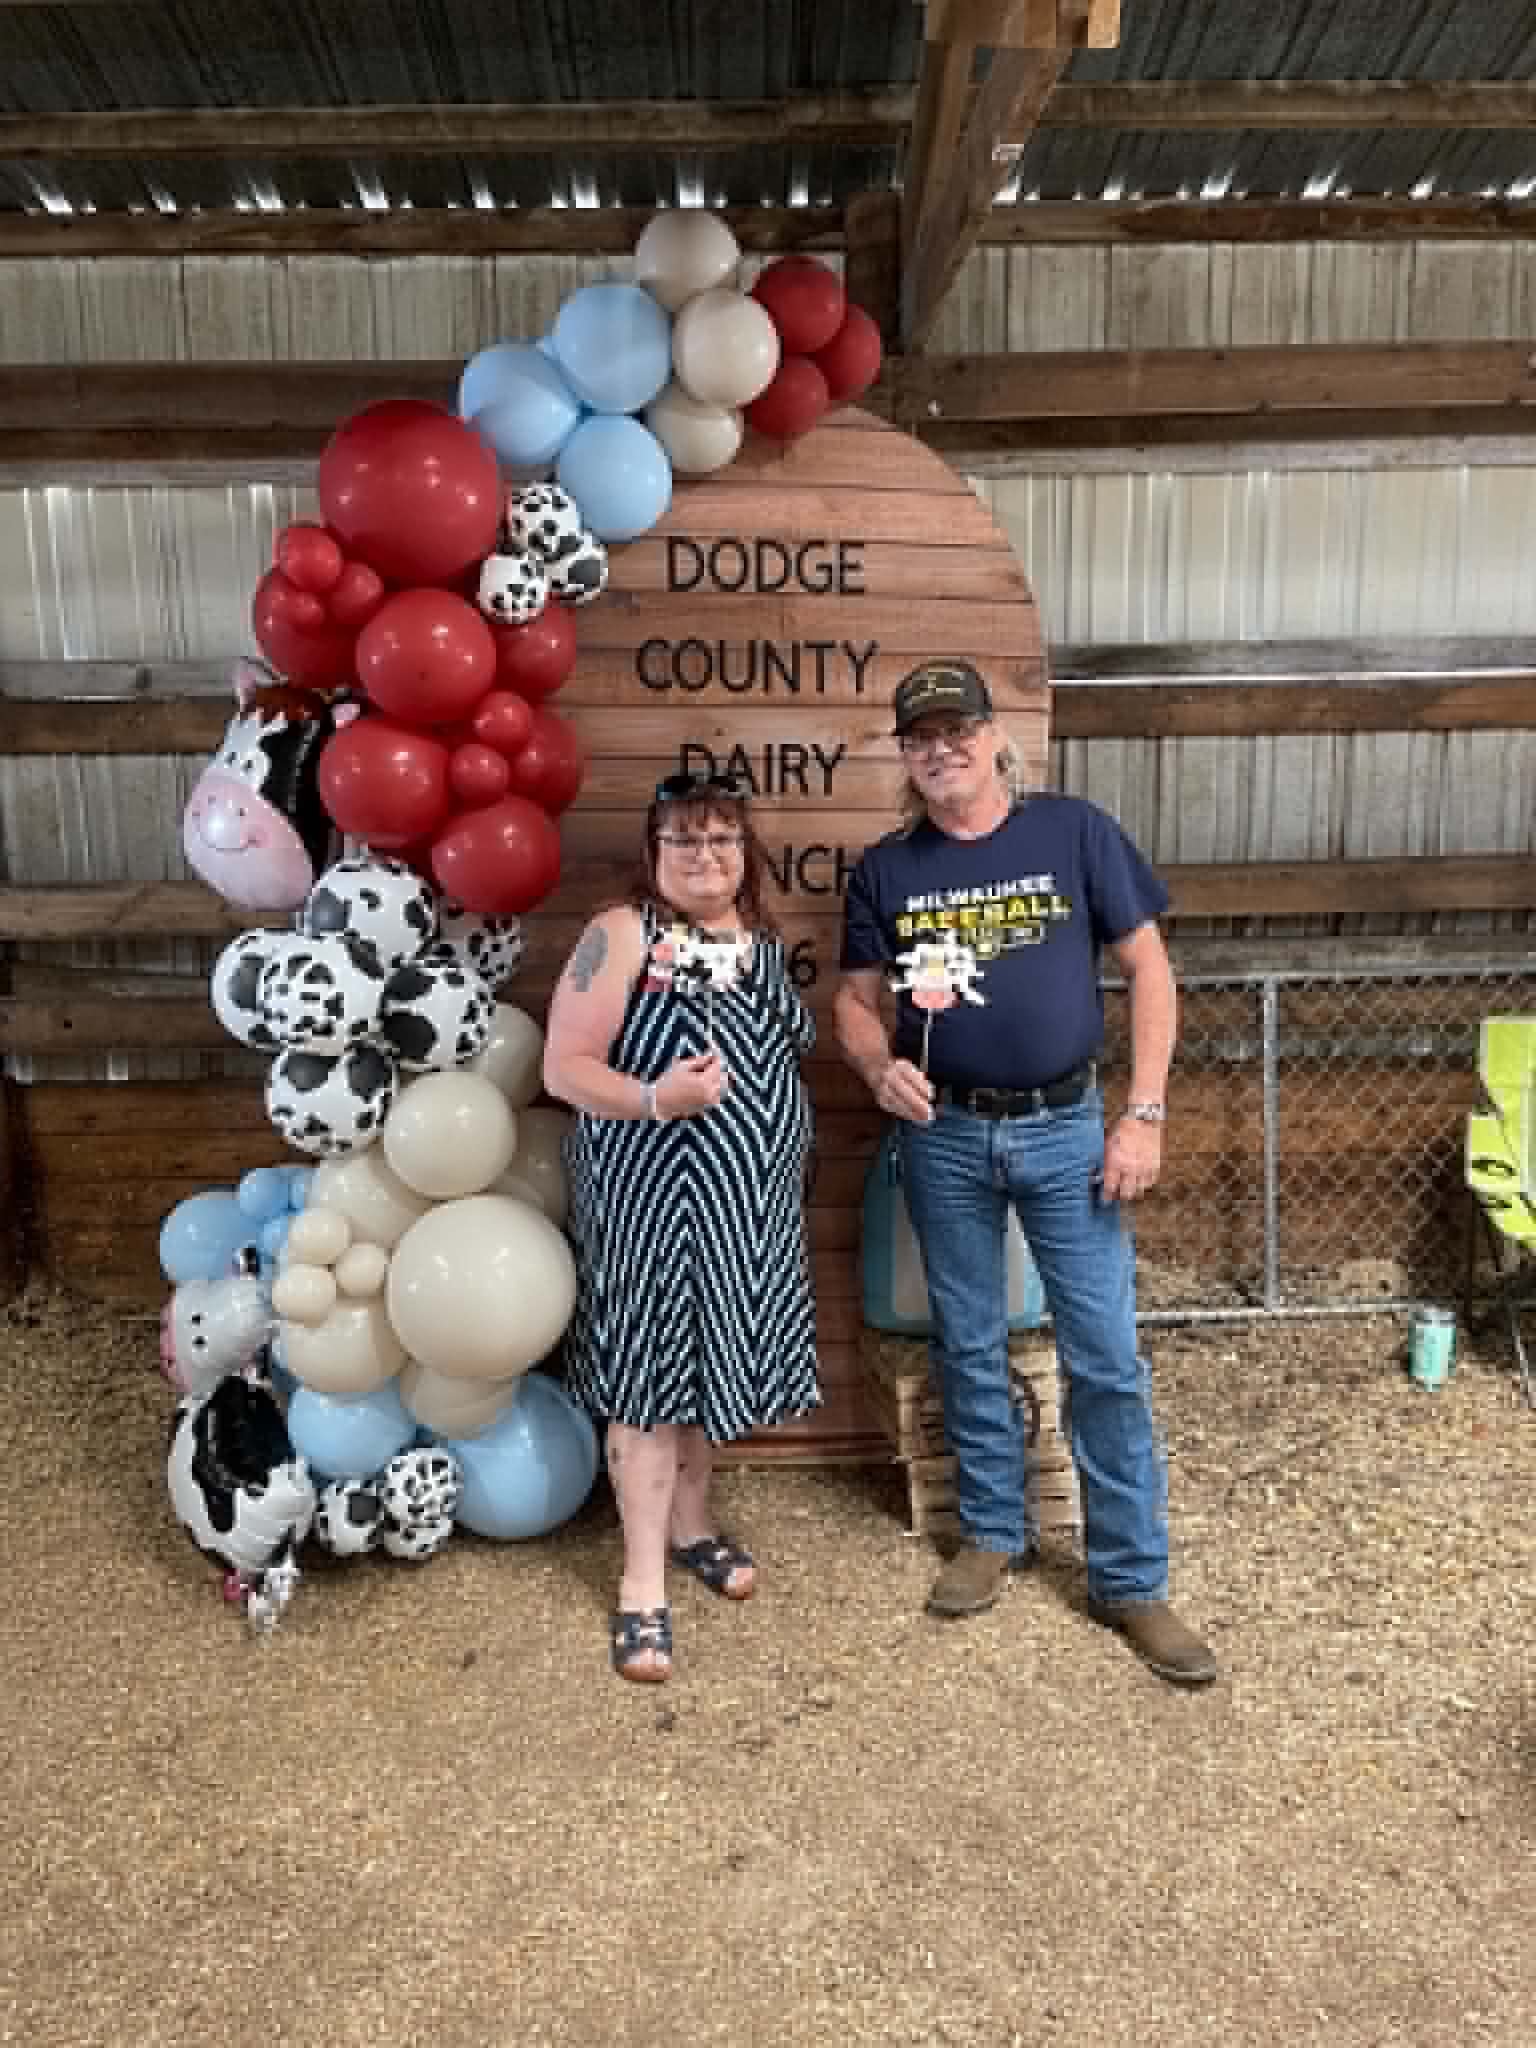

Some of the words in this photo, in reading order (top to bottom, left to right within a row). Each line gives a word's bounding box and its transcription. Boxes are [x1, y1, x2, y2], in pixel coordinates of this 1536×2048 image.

[666, 537, 865, 593] DODGE
[636, 638, 879, 693] COUNTY
[679, 742, 848, 796] DAIRY
[905, 872, 1055, 912] MILWAUKEE
